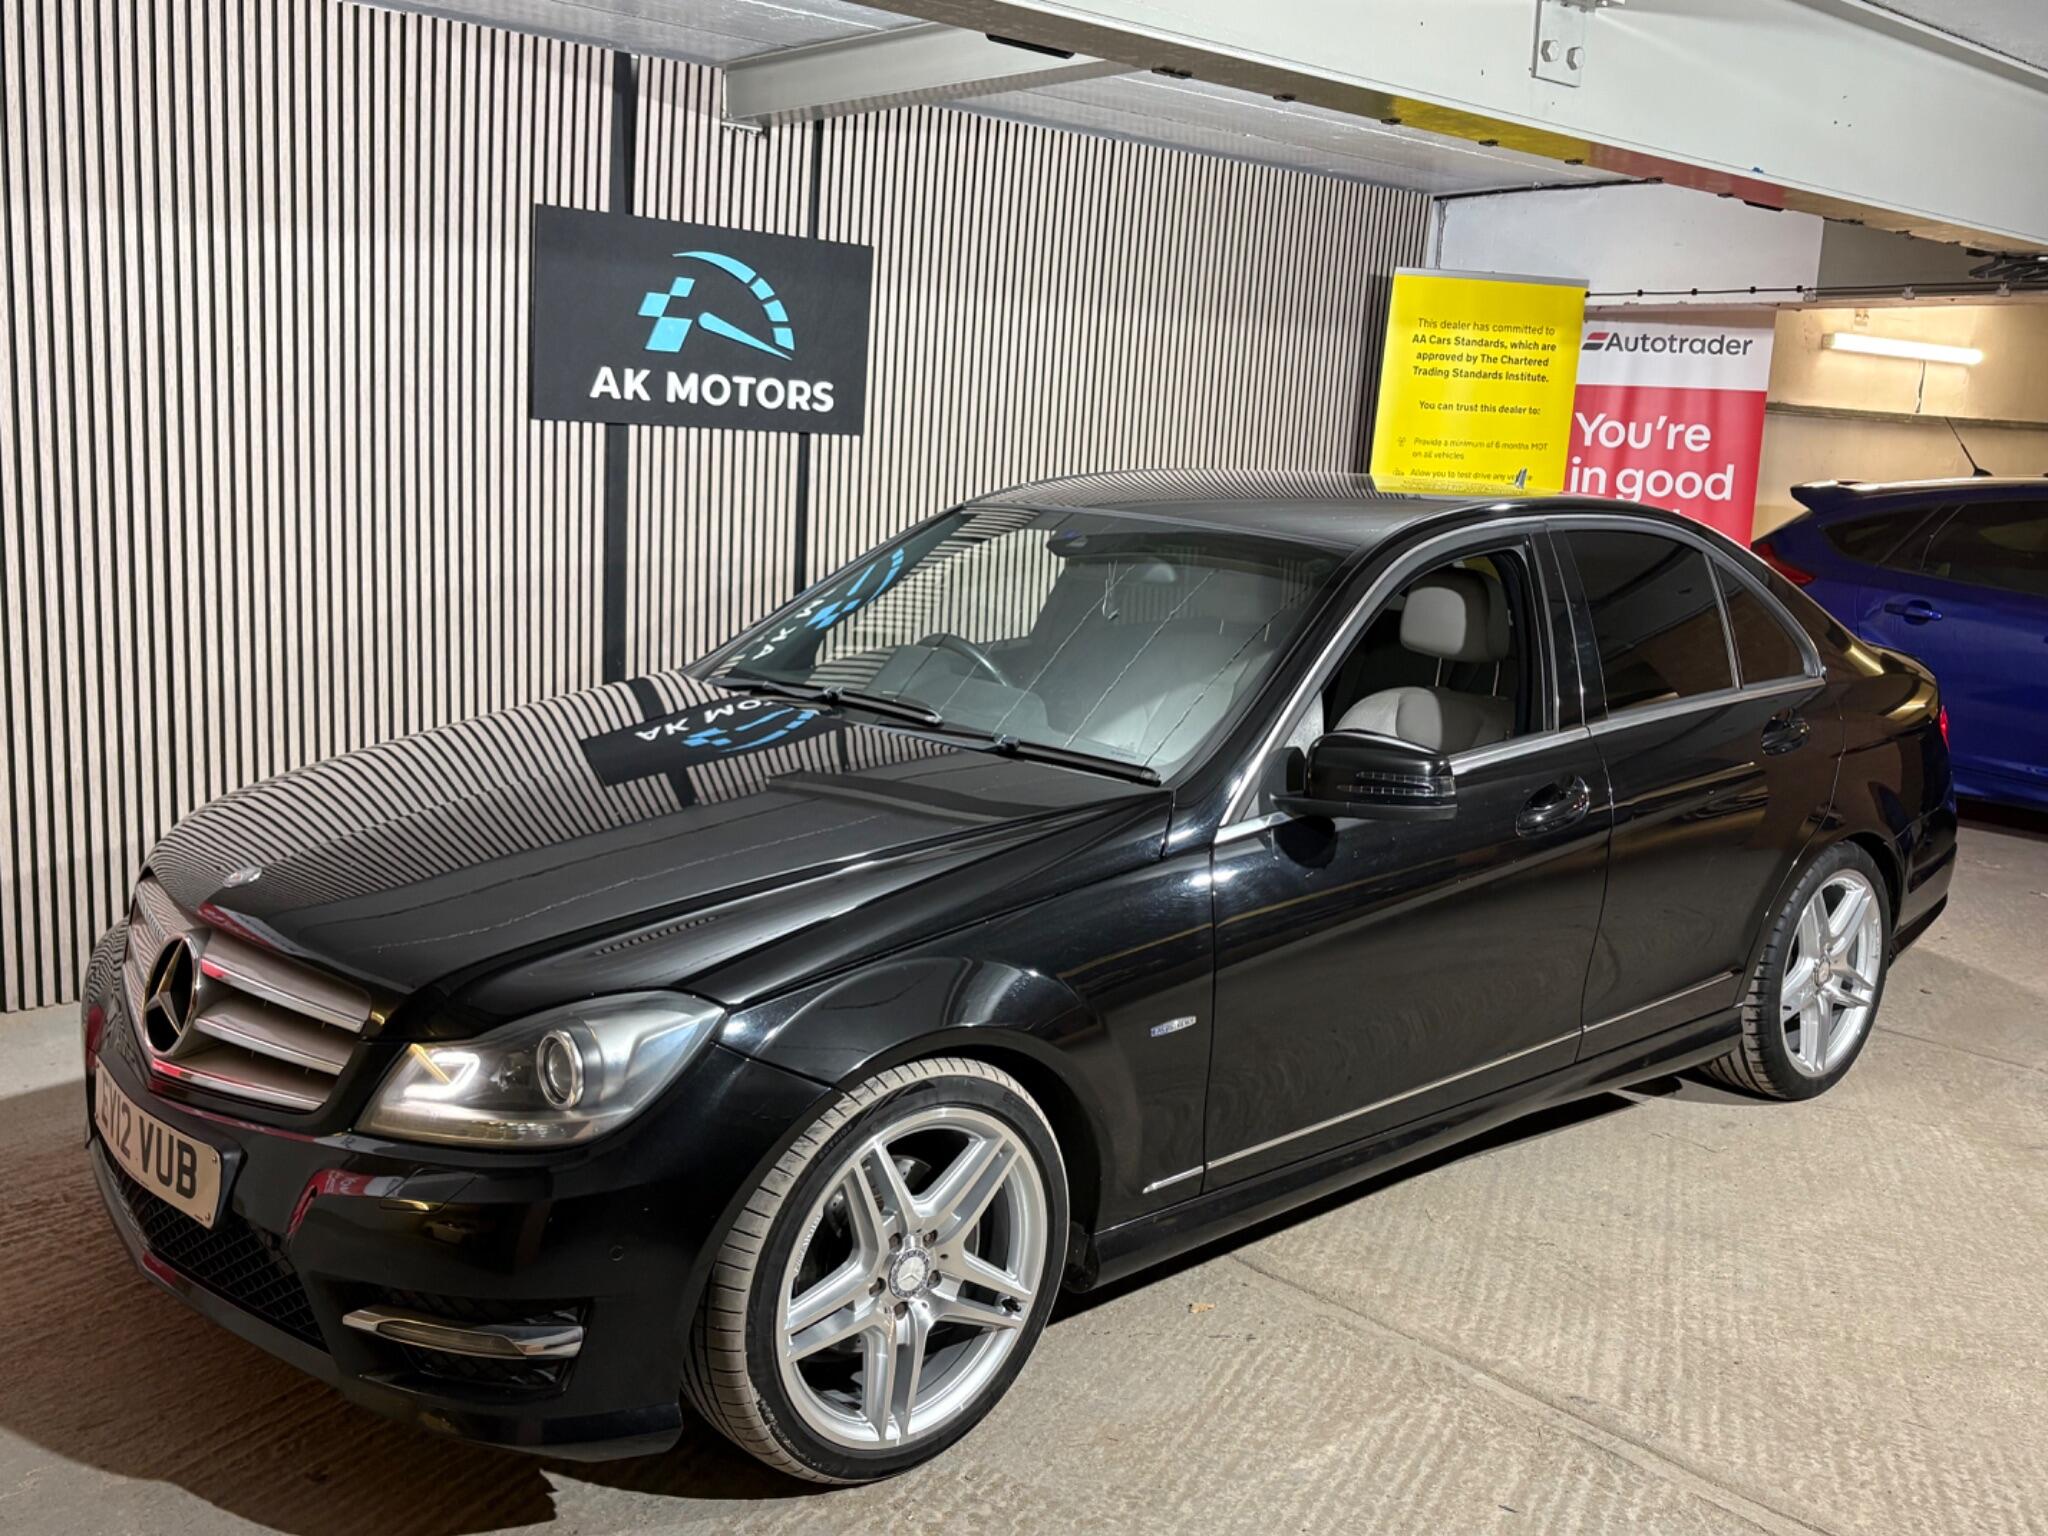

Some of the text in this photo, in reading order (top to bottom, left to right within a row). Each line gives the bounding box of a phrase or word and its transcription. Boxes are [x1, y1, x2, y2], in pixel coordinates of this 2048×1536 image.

[1418, 318, 1555, 336] This dealer has committed to
[1412, 334, 1556, 352] AA Cars Standards, which are
[1605, 333, 1753, 356] Autotrader
[1416, 351, 1549, 366] approved by The Chartered
[1412, 366, 1549, 383] Trading Standards Institute.
[590, 366, 835, 412] AK MOTORS
[1419, 400, 1541, 415] You can trust this dealer to:
[1414, 437, 1442, 447] Provide
[1450, 440, 1485, 448] minimum
[1502, 442, 1529, 450] months
[1531, 442, 1548, 451] MOT
[1434, 452, 1464, 460] vehicles
[1411, 468, 1431, 476] Allow
[1570, 456, 1734, 502] in good
[139, 1115, 198, 1200] VUB
